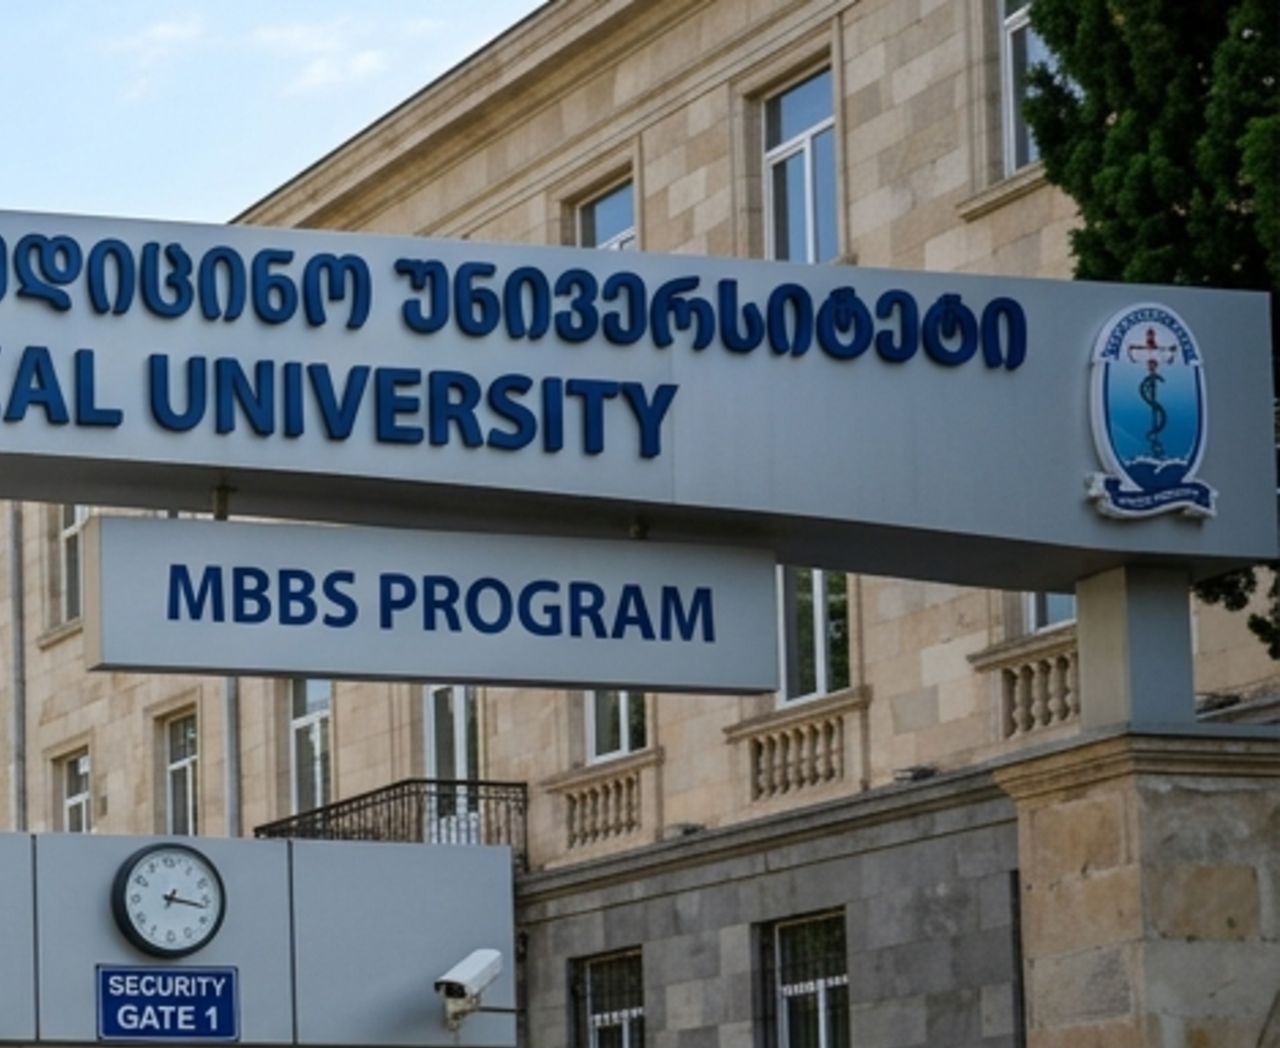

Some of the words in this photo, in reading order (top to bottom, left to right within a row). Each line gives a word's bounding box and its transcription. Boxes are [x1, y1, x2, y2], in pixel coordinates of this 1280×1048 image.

[393, 257, 1028, 371] უნივერსიტეტი
[148, 353, 679, 460] UNIVERSITY
[166, 563, 359, 629] MBBS
[379, 573, 717, 643] PROGRAM
[108, 975, 226, 997] SECURITY
[117, 1004, 196, 1030] GATE
[204, 1005, 218, 1030] 1
